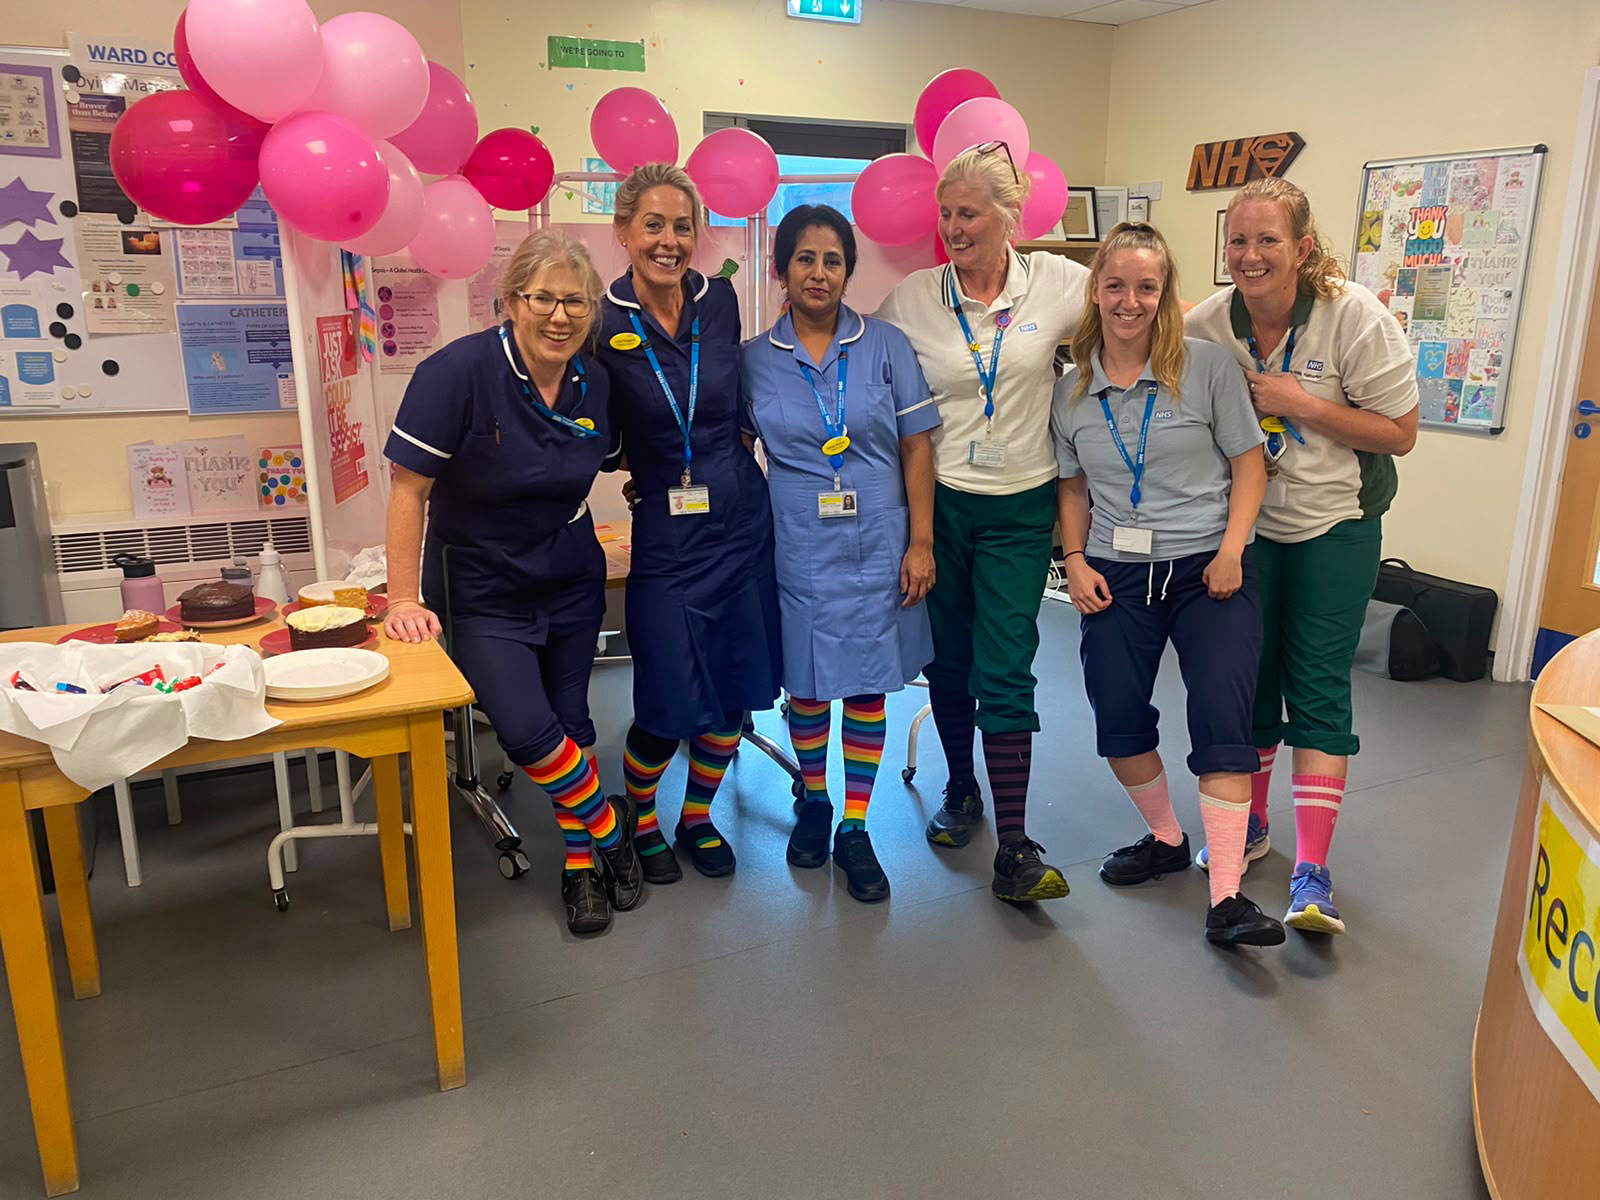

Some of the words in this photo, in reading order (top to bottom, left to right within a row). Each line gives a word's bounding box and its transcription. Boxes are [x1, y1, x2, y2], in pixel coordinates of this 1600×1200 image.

[88, 44, 147, 64] WARD
[153, 51, 177, 67] CO
[560, 45, 585, 55] WE'RE
[587, 48, 614, 57] GOING
[615, 50, 625, 58] TO
[1186, 133, 1295, 190] NHS
[1410, 206, 1448, 221] THANK
[1407, 219, 1446, 240] YOU
[1470, 256, 1518, 269] THANK
[1479, 273, 1504, 285] YOU
[1021, 324, 1036, 332] NHS
[323, 331, 342, 358] JUST
[325, 354, 343, 384] ASK
[1308, 361, 1322, 369] NHS
[327, 379, 351, 408] COULD
[328, 407, 337, 434] IT
[336, 403, 349, 433] BE
[330, 421, 362, 458] SEPSIS?
[184, 455, 251, 472] THANK
[199, 477, 237, 491] YOU
